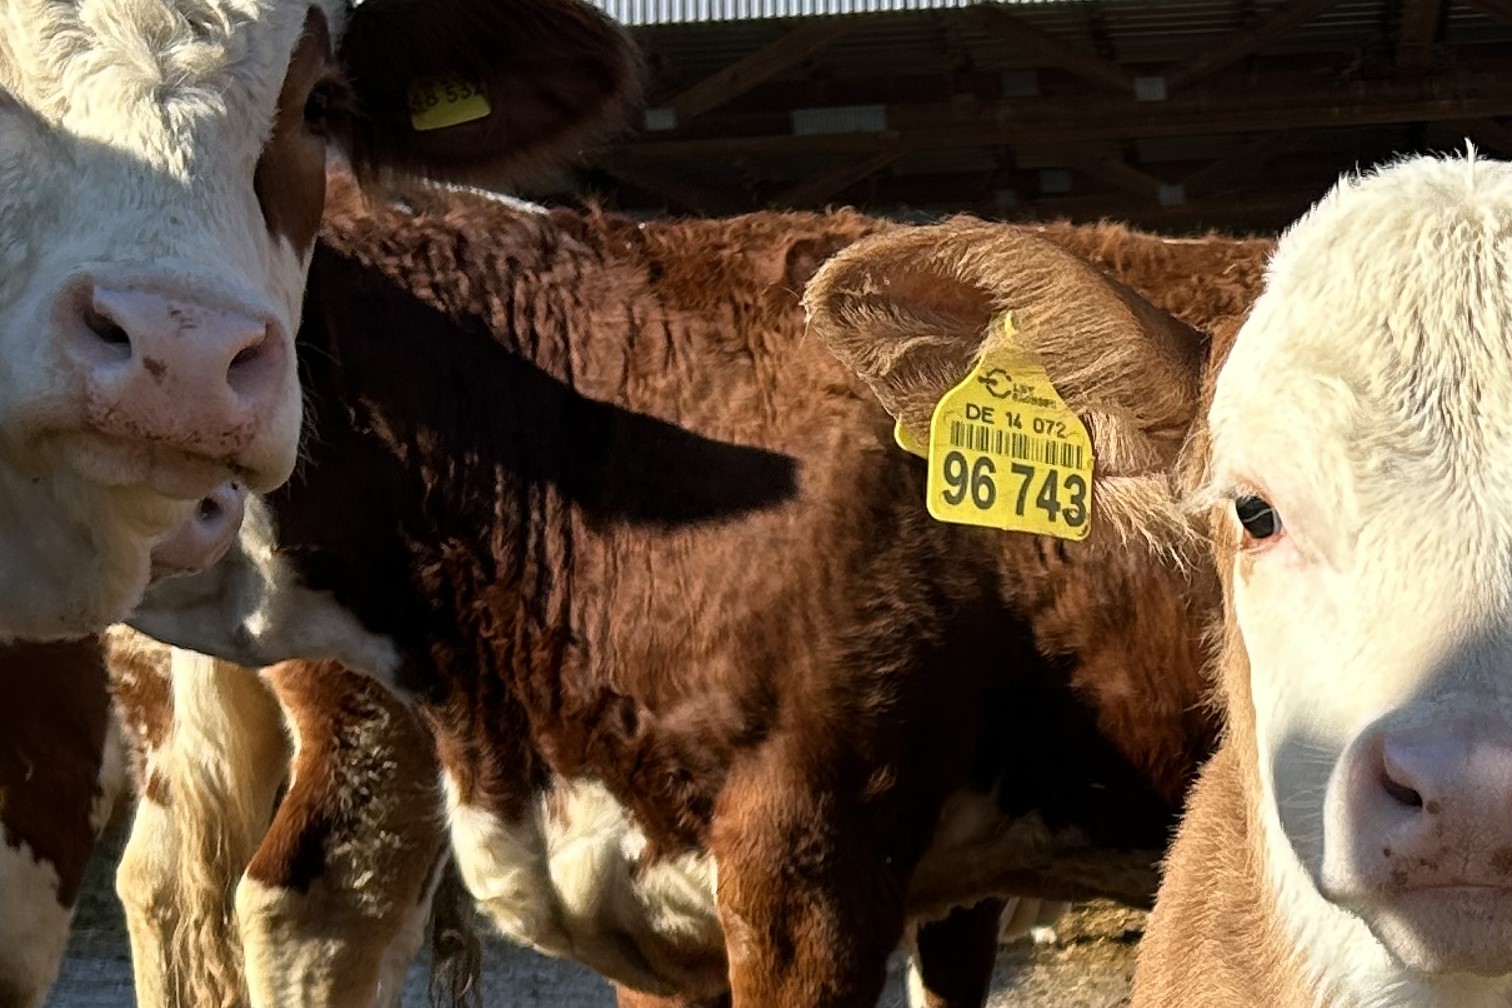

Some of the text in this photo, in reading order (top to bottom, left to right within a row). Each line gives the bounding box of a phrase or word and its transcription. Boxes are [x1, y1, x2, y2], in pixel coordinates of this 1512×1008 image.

[965, 402, 1067, 439] DE 14 072
[942, 450, 1087, 528] 96 743
